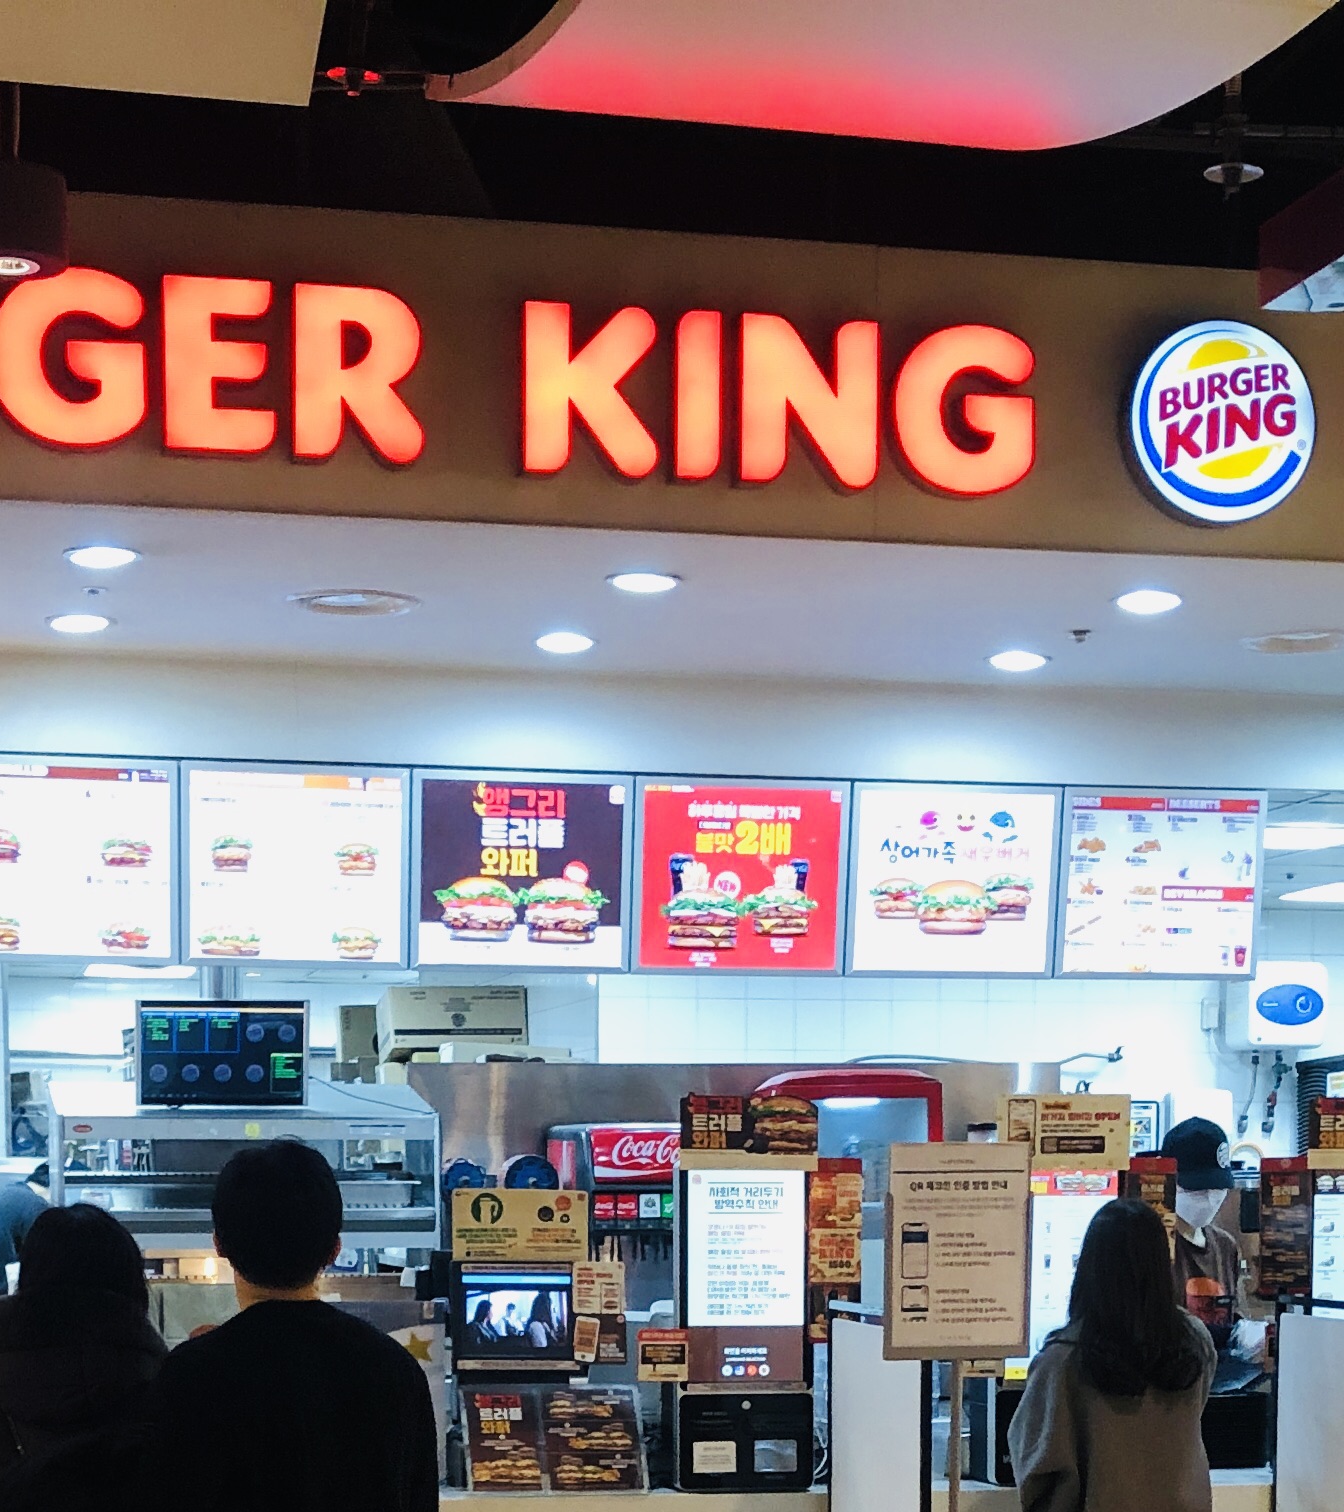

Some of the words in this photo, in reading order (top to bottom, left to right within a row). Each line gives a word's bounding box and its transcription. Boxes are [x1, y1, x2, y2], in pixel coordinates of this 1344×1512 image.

[523, 300, 1036, 496] KING
[1158, 363, 1291, 423] BURGER
[1160, 391, 1298, 472] KING
[482, 786, 566, 819] 앵그리
[480, 817, 565, 849] 트러플
[735, 820, 792, 856] 2배
[479, 848, 539, 878] 와퍼
[879, 837, 957, 864] 상어가족
[960, 846, 1031, 863] 새우버거
[717, 880, 737, 892] NEW
[709, 1186, 739, 1198] 사회적
[743, 1186, 784, 1199] 거리두기
